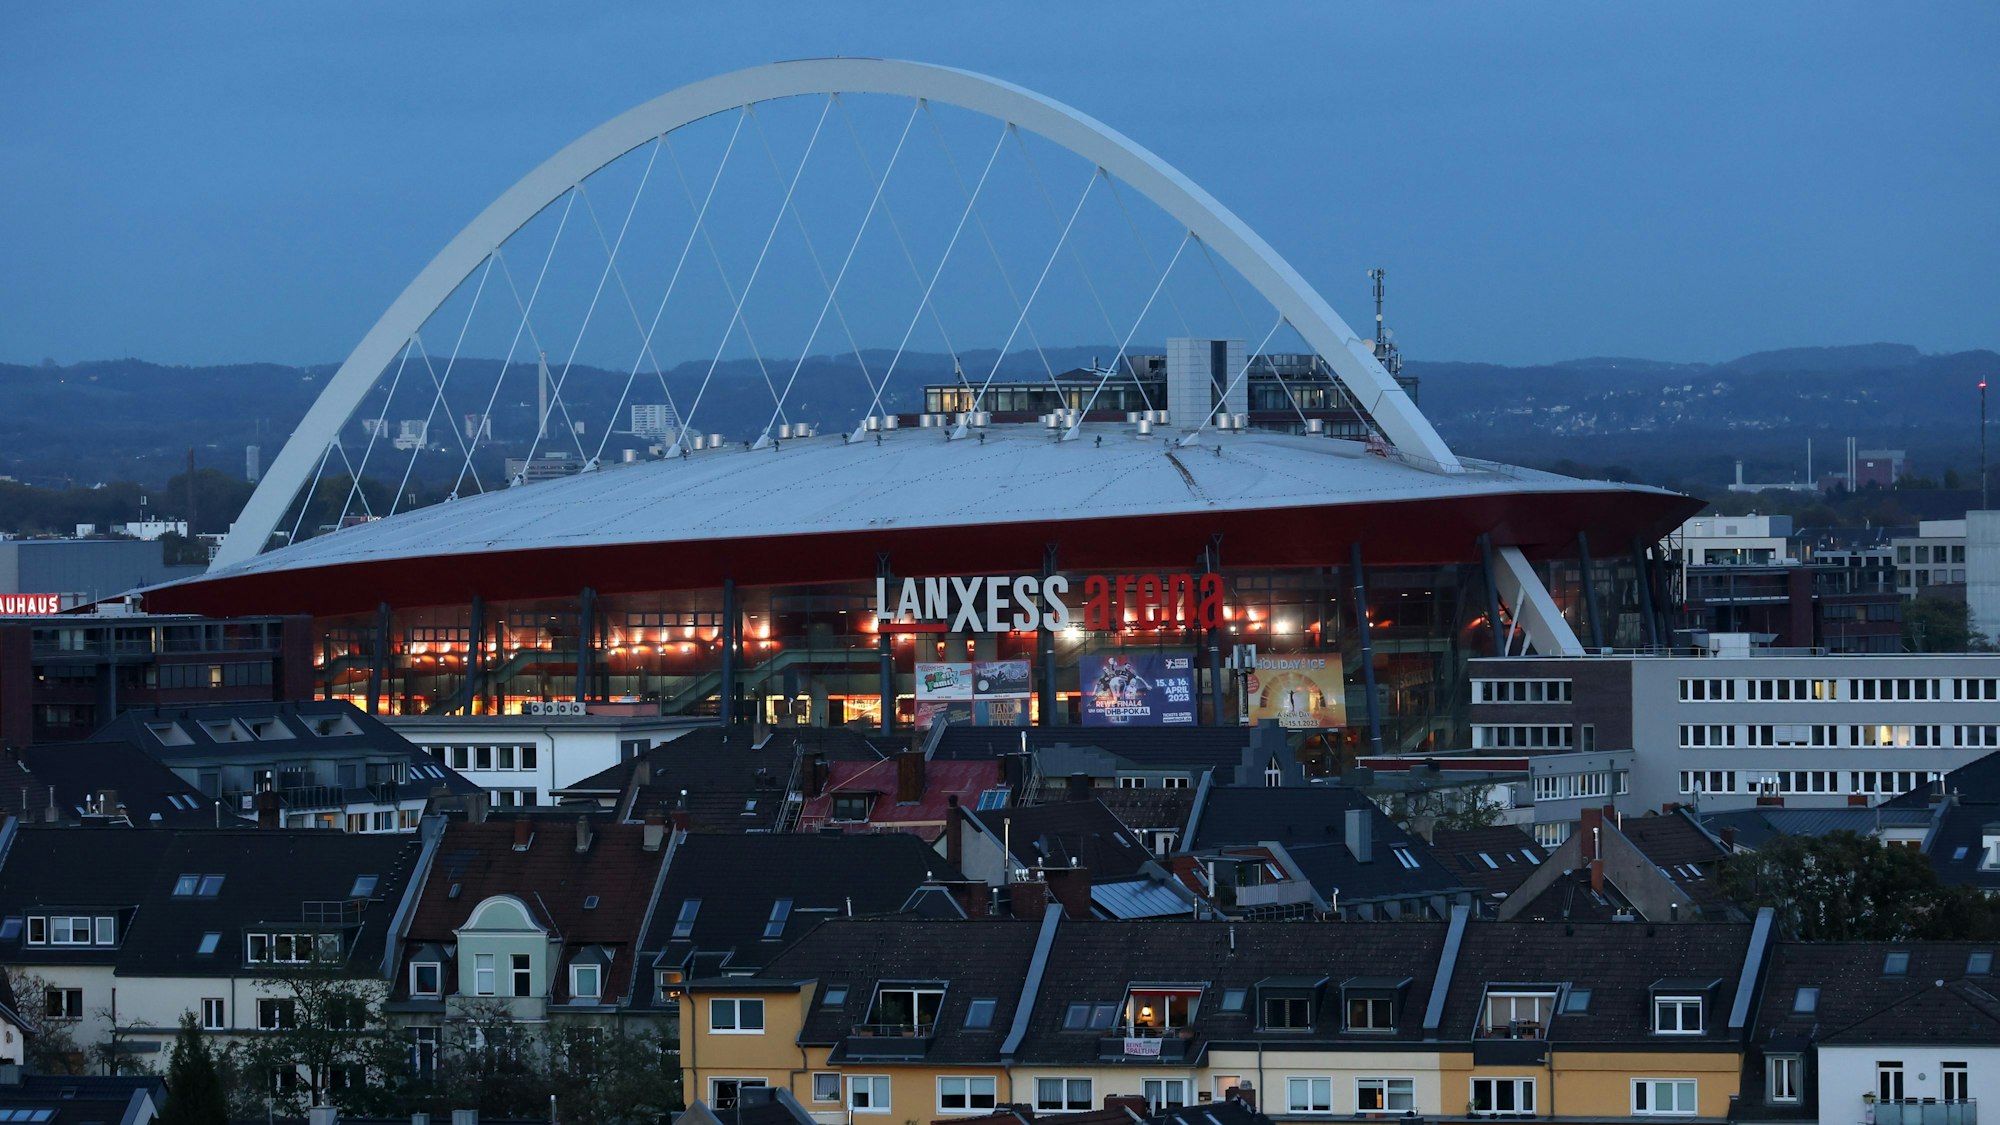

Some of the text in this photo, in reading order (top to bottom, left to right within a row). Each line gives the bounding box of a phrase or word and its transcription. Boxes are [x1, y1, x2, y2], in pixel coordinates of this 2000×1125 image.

[876, 573, 1225, 632] LANXESS arena
[1256, 659, 1301, 670] HOLIDAY
[1308, 658, 1325, 670] ICE
[1156, 678, 1189, 687] 15. & 16.
[1165, 686, 1189, 694] APRIL
[1168, 694, 1190, 702] 2023
[989, 703, 1015, 714] HANS
